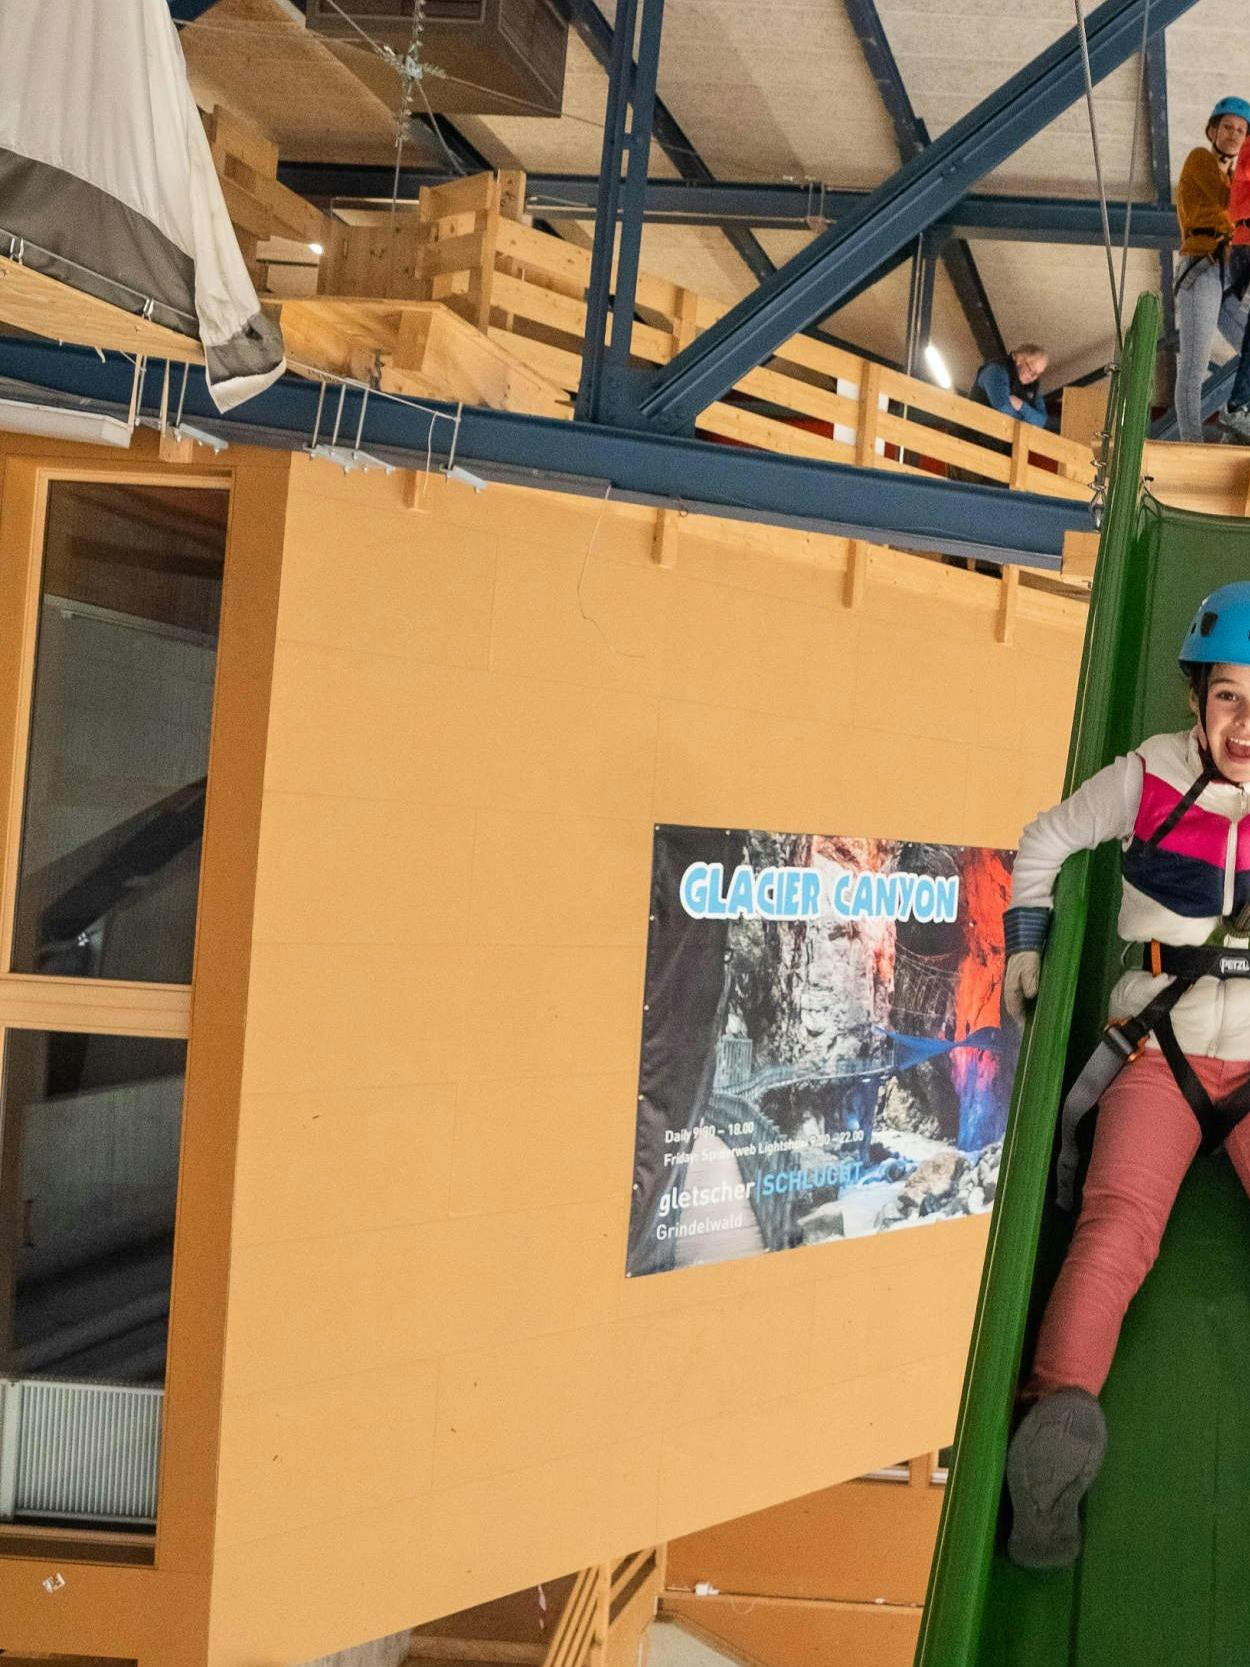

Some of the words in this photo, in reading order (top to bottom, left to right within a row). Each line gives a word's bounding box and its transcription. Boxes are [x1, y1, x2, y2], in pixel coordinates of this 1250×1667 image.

[681, 862, 821, 919] GLACIER
[834, 871, 959, 923] CANYON
[1220, 957, 1250, 974] PETZL
[664, 1128, 691, 1144] Daily
[729, 1121, 754, 1136] 18.00
[659, 1180, 755, 1217] gletscher
[656, 1214, 743, 1240] Grindelwald
